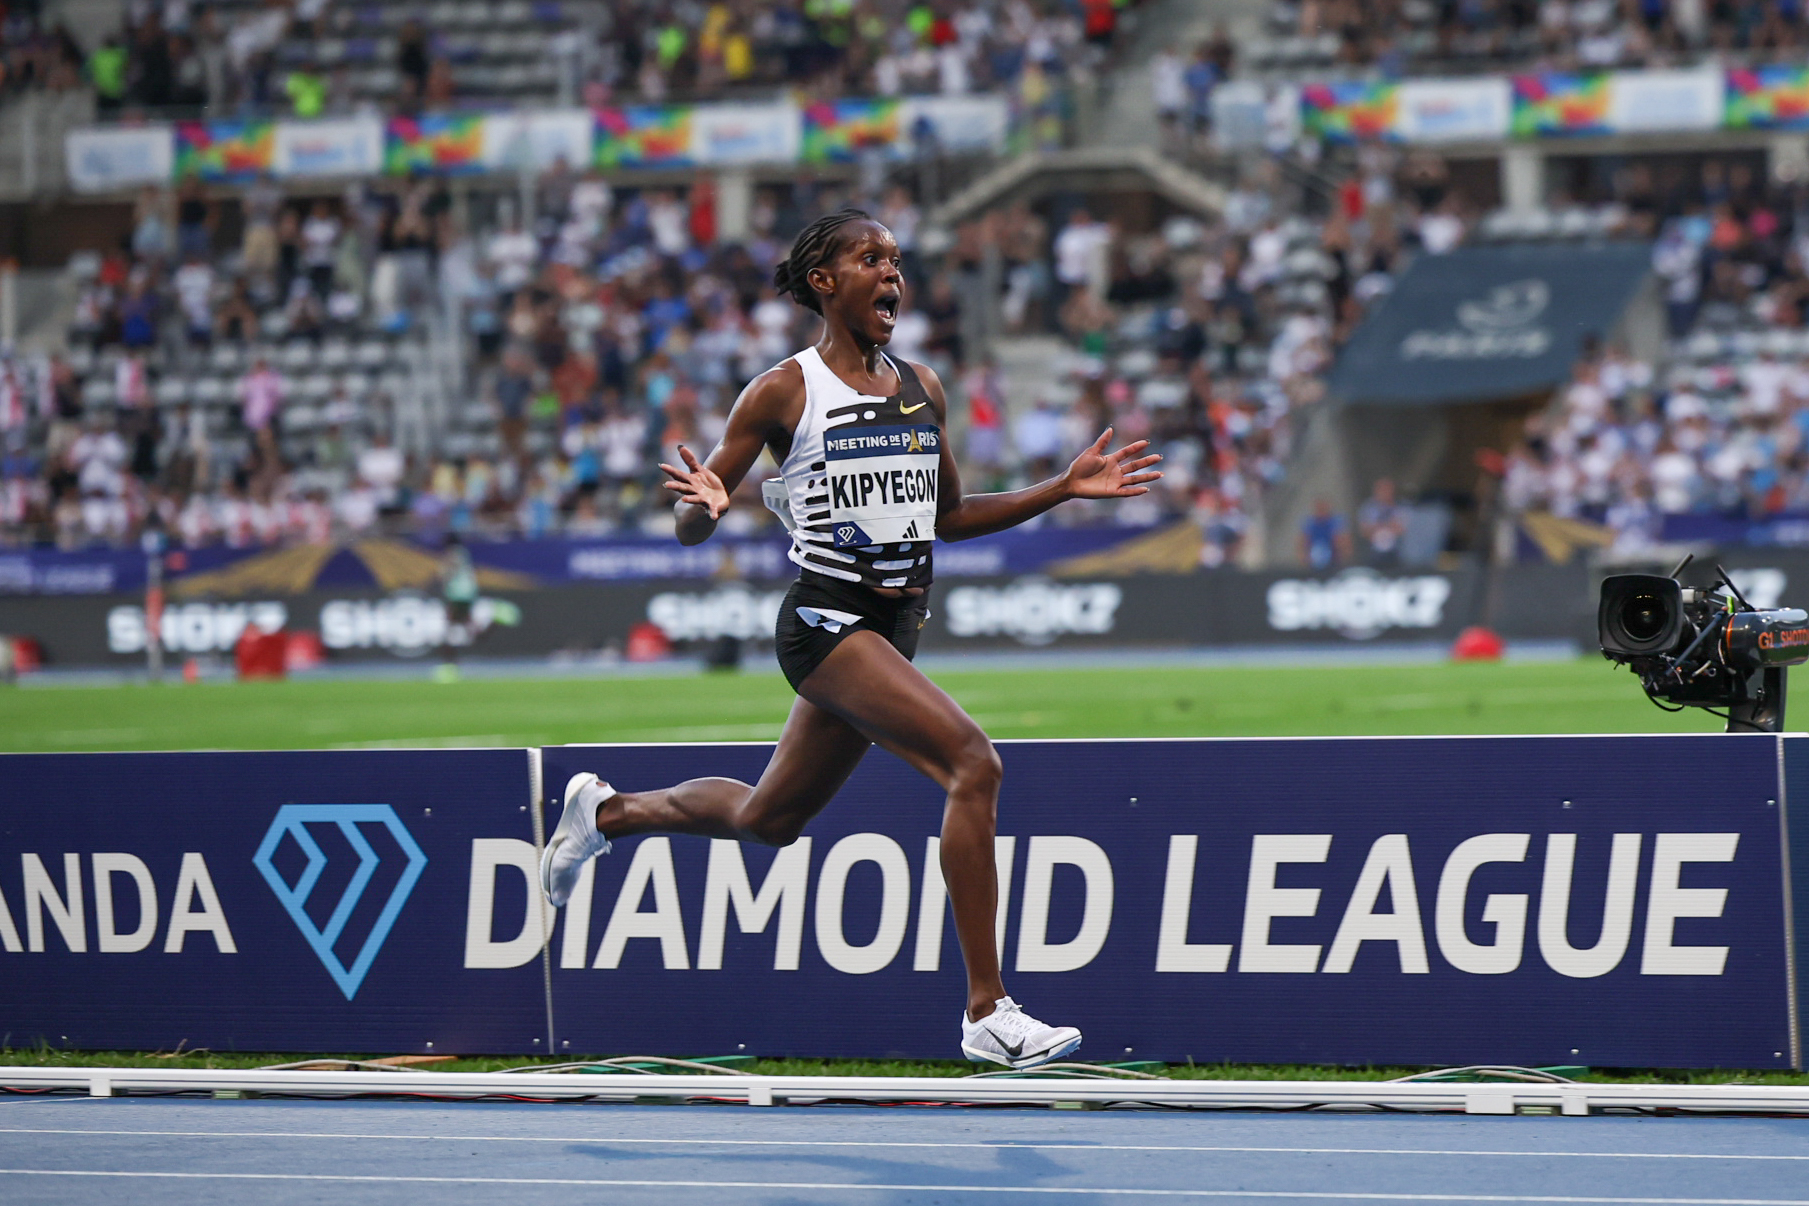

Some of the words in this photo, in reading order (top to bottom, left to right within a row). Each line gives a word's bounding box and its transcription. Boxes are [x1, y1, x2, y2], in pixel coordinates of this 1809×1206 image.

[827, 436, 888, 452] MEETING
[889, 435, 901, 446] DE
[831, 468, 936, 509] KIPYEGON
[464, 832, 1114, 975] DIAMOND
[1155, 833, 1741, 978] LEAGUE
